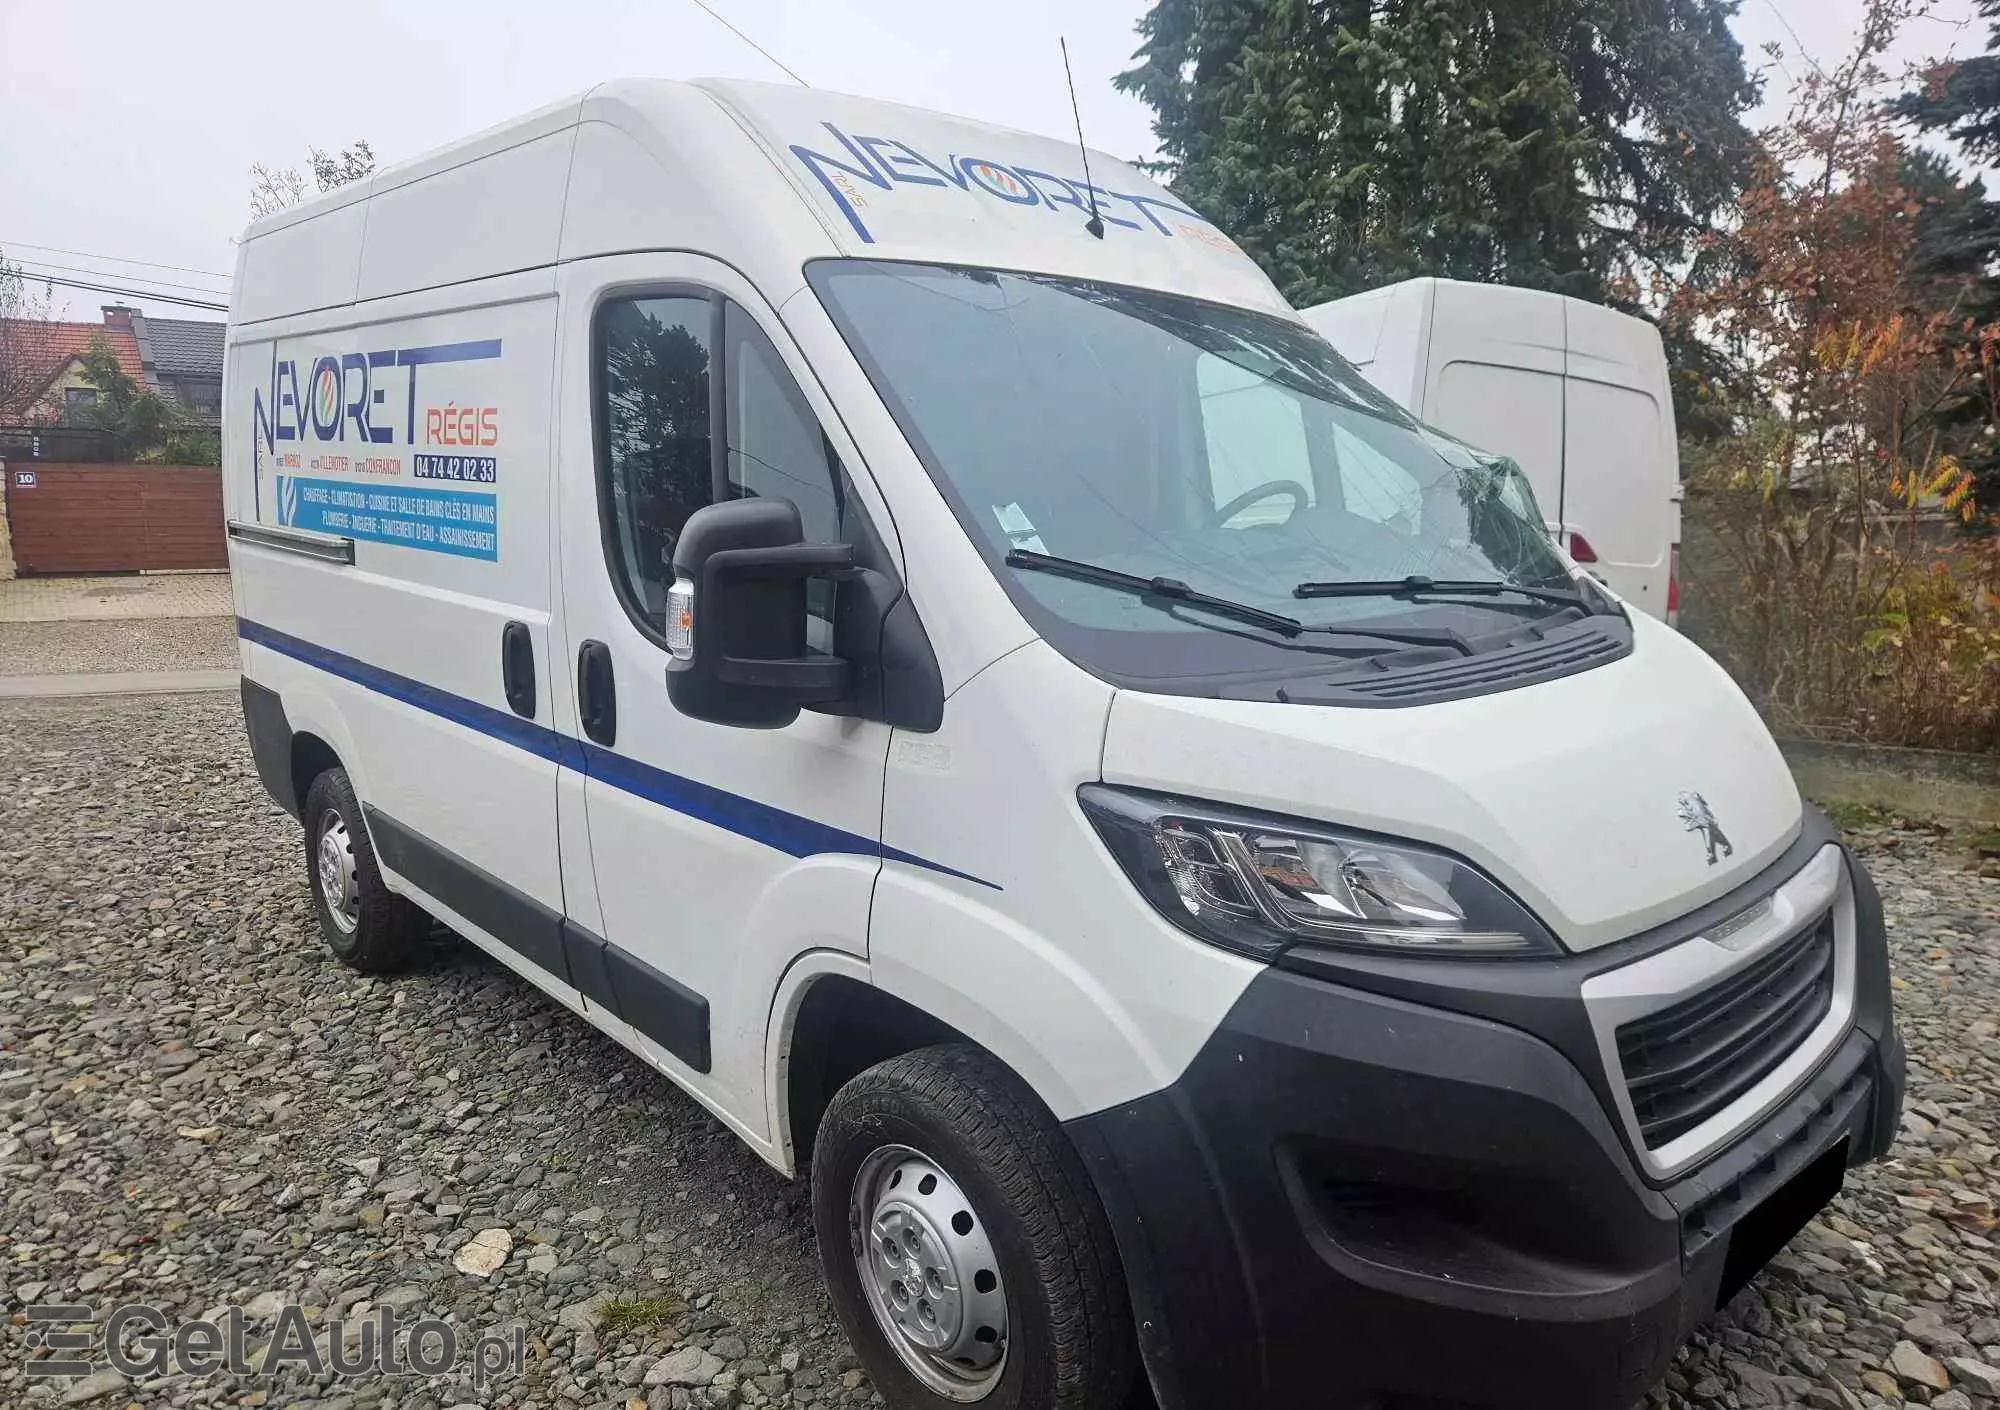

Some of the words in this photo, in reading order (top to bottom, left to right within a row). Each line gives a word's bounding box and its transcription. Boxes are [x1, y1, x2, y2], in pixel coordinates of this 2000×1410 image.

[789, 121, 1203, 244] NEVORET
[254, 338, 502, 522] NEVORET
[427, 401, 498, 446] RÉGIS
[19, 474, 34, 483] 10
[416, 456, 429, 477] 04
[431, 457, 444, 478] 74
[446, 457, 460, 479] 42
[463, 458, 477, 480] 02
[480, 459, 494, 481] 33
[390, 496, 398, 513] ET
[399, 497, 416, 515] SALLE
[416, 499, 426, 516] DE
[462, 503, 471, 521] EN
[472, 504, 495, 524] MAINS
[440, 527, 495, 551] ASSAINISSEMENT
